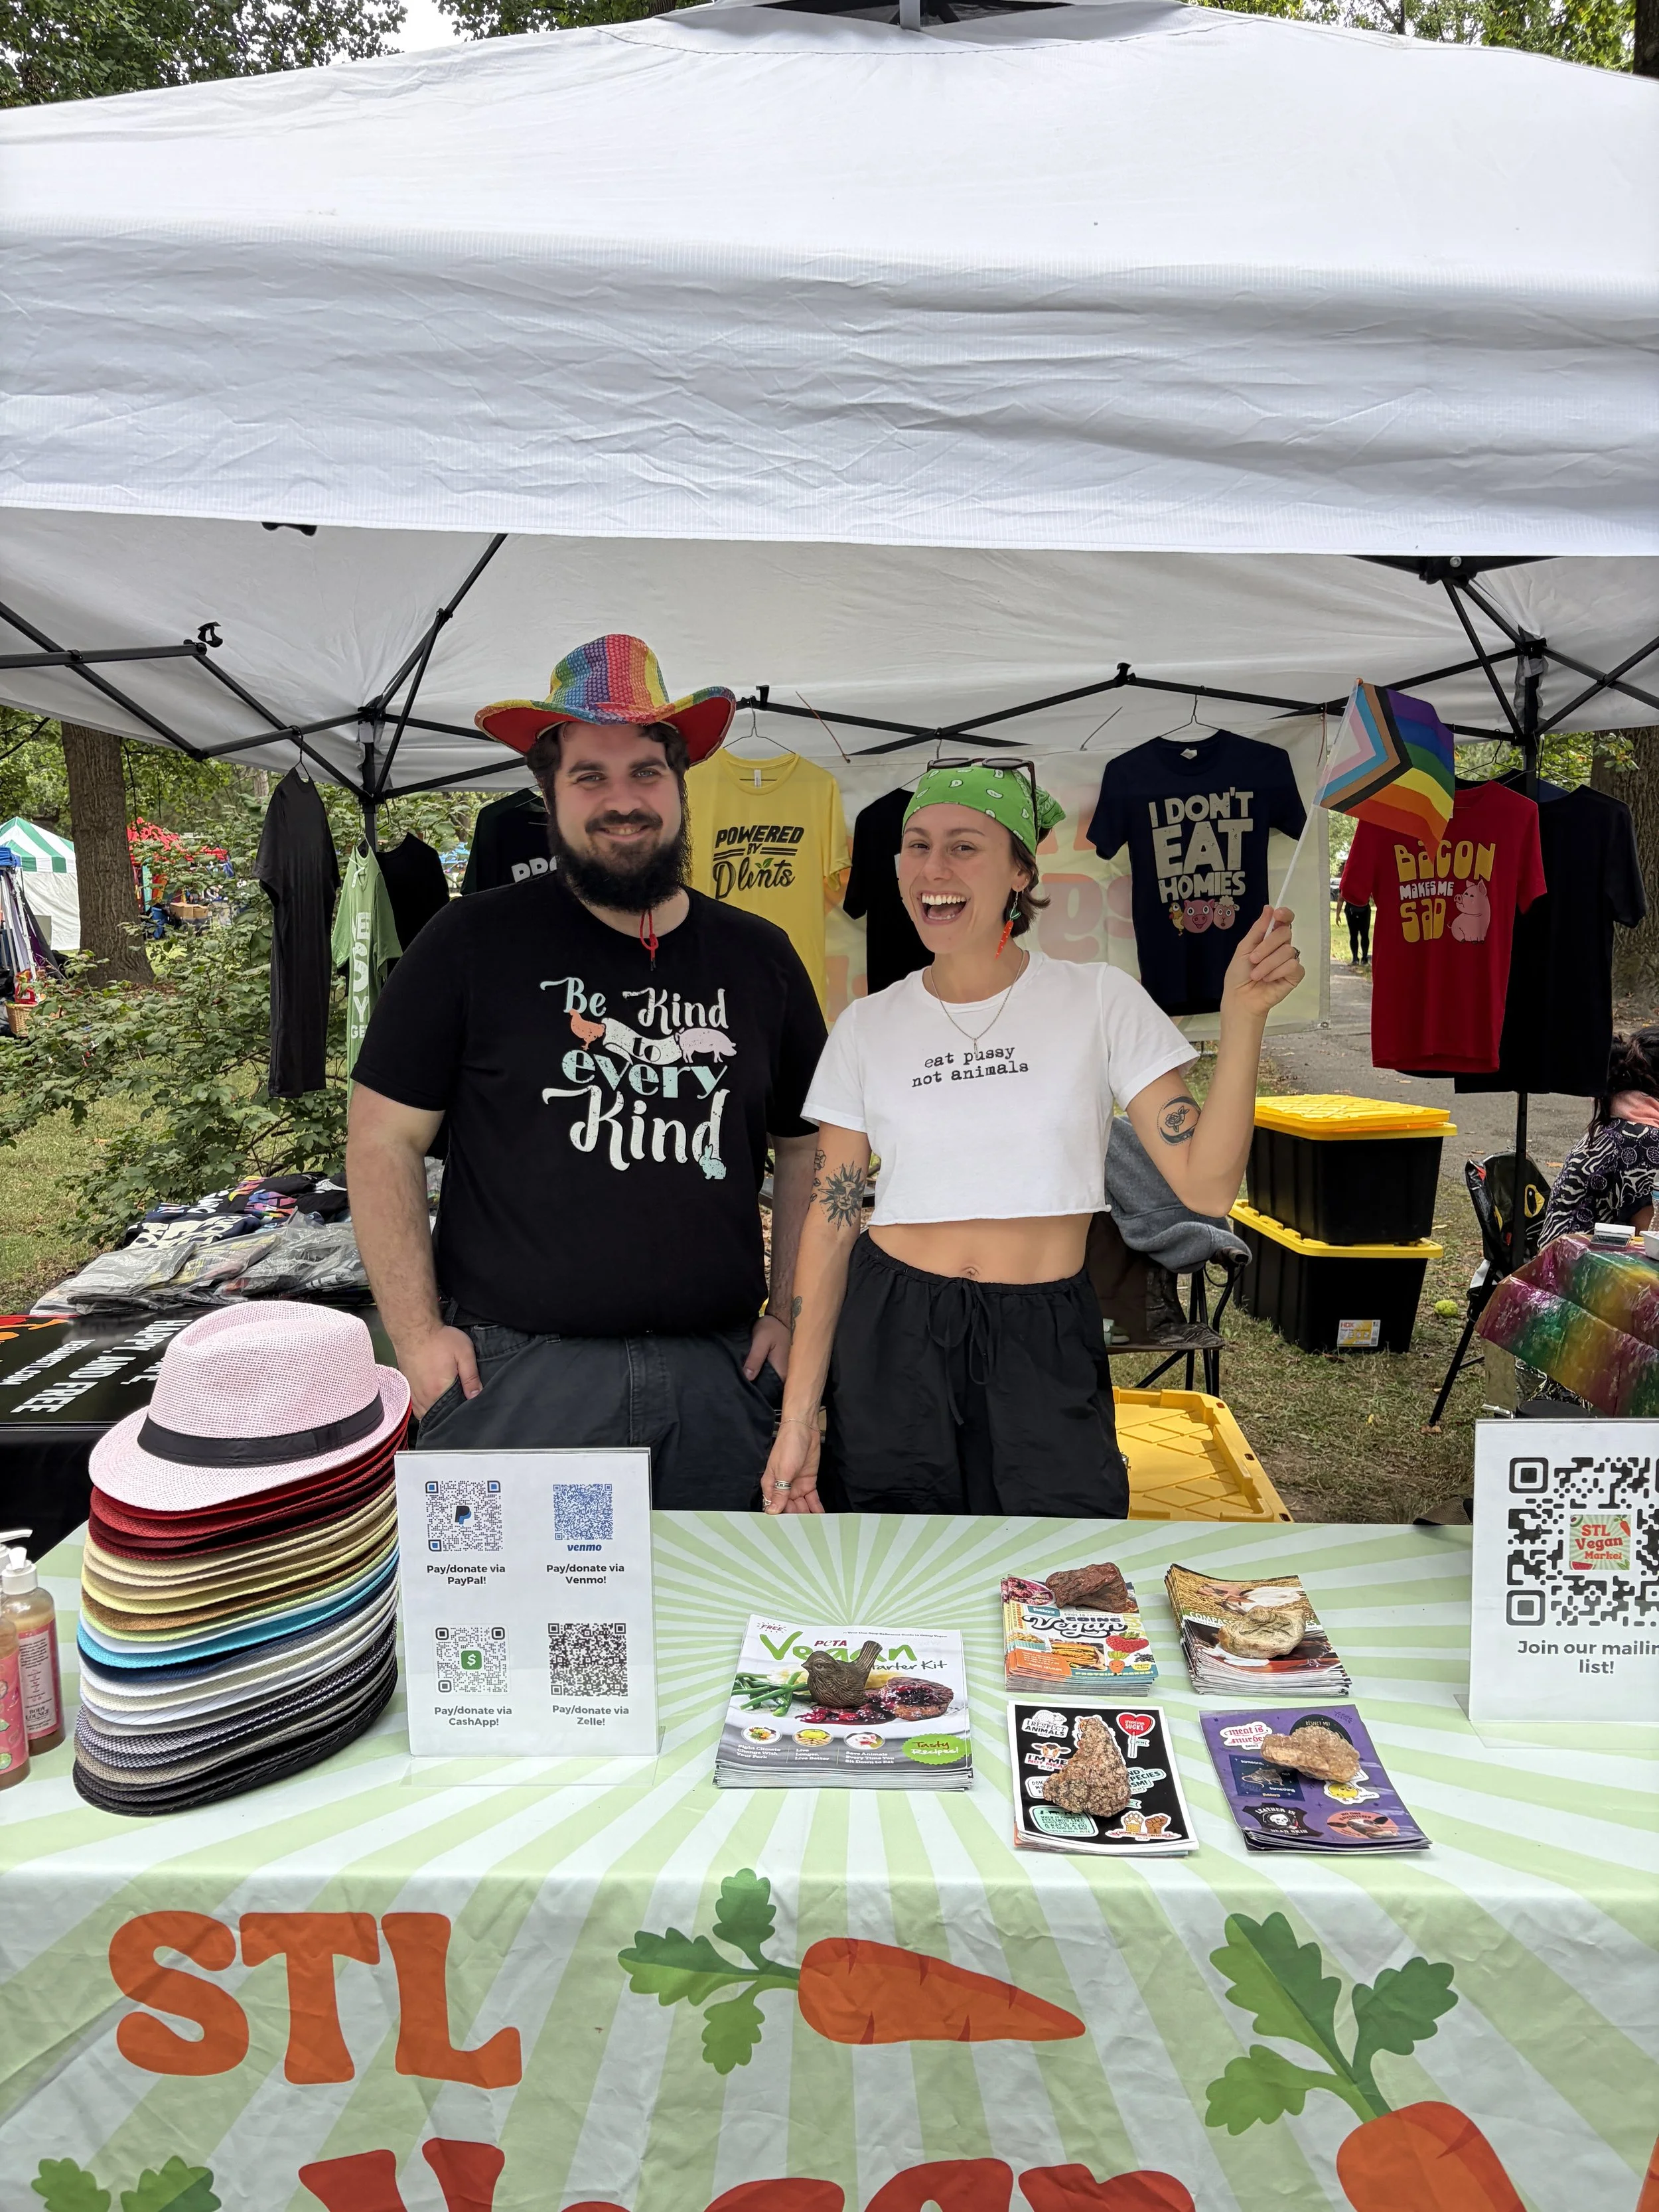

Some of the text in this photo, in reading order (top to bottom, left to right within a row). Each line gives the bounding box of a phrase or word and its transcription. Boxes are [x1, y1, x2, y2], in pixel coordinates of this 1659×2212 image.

[1149, 802, 1158, 828] I
[1165, 786, 1254, 825] DON'T
[715, 825, 804, 848] POWERED
[747, 843, 763, 855] BY
[1152, 818, 1254, 879] EAT
[1158, 871, 1246, 904] HOMIES
[1437, 881, 1454, 896] ME
[540, 977, 729, 1035] Be Kind
[632, 1037, 661, 1062] to
[924, 1047, 1015, 1068] eat pussy
[562, 1049, 728, 1100] every
[912, 1061, 1029, 1088] not animals
[542, 1085, 730, 1171] Kind
[0, 1339, 96, 1386] VEGANSTL.COM
[10, 1319, 192, 1413] HAPPY, AND FREE
[1581, 1524, 1611, 1537] STL
[1575, 1536, 1623, 1551] Vegan
[1584, 1550, 1623, 1560] Market
[427, 1564, 506, 1575] Pay/donate via
[546, 1563, 624, 1575] Pay/donate via
[447, 1576, 486, 1586] PayPal!
[565, 1575, 607, 1585] Venmo!
[1022, 1615, 1128, 1639] Vegan
[1518, 1641, 1659, 1655] Join our mailin
[873, 1660, 948, 1670] tarter Kit
[1579, 1660, 1615, 1674] list!
[434, 1706, 512, 1718] Pay/donate via
[552, 1705, 630, 1717] Pay/donate via
[449, 1717, 499, 1728] CashApp!
[577, 1716, 605, 1726] Zelle!
[1031, 1721, 1066, 1732] RESPECT
[1025, 1726, 1064, 1736] ANIMALS
[910, 1746, 960, 1755] Recipes!
[912, 1740, 950, 1749] Tasty
[1129, 1771, 1161, 1781] PECIES
[108, 1909, 523, 2090] STL
